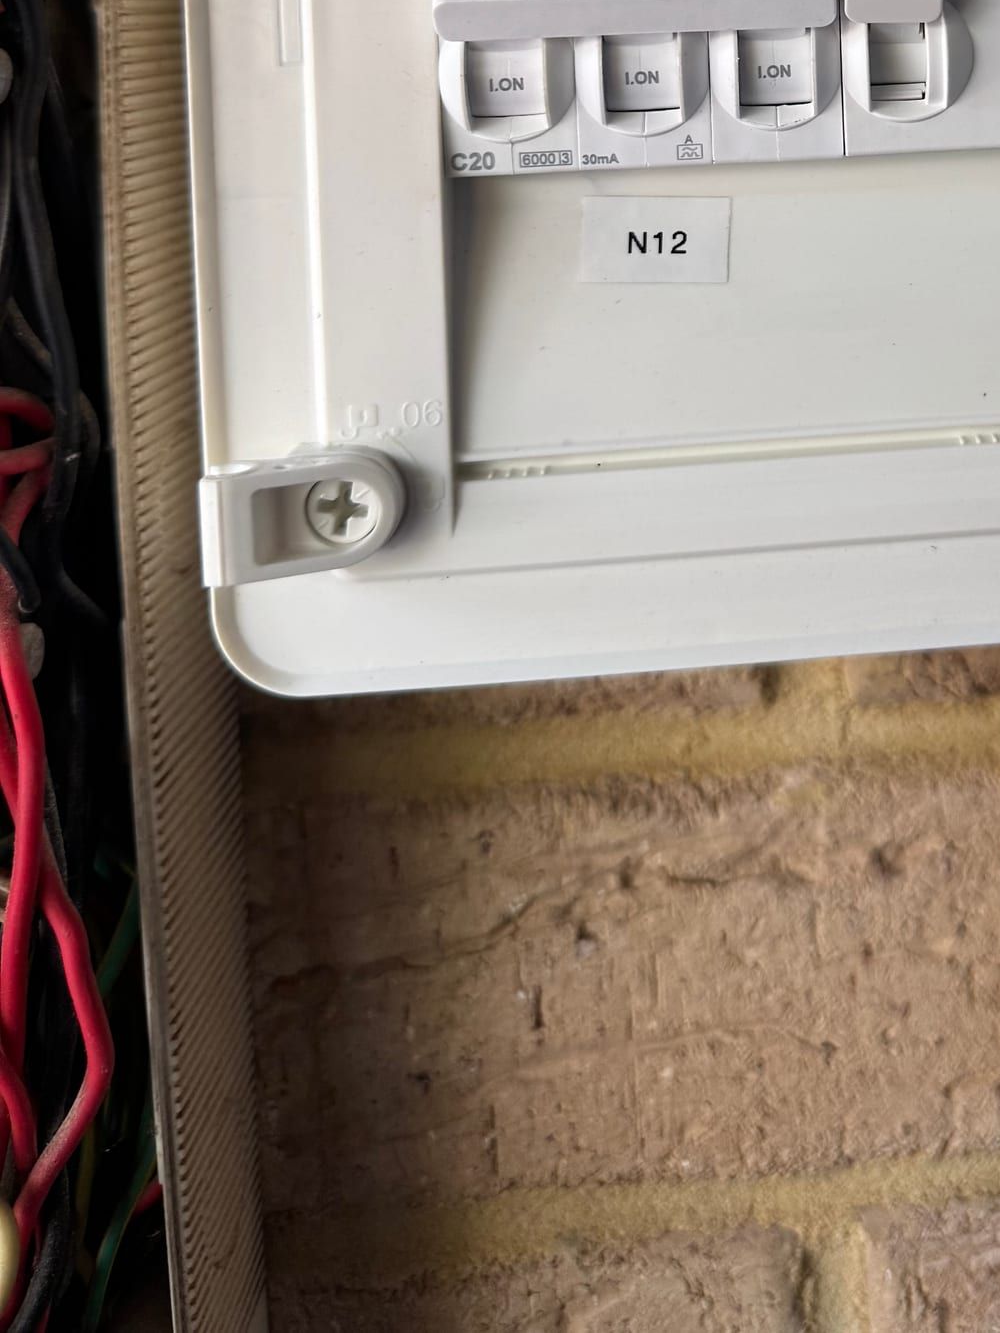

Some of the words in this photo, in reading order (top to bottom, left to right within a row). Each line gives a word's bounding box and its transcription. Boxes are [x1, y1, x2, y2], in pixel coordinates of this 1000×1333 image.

[624, 70, 660, 86] I.ON
[757, 64, 792, 79] I.ON
[489, 77, 525, 92] I.ON
[684, 134, 693, 144] A
[450, 152, 496, 171] C20
[522, 154, 556, 166] 6000
[561, 152, 571, 164] 3
[581, 153, 620, 165] 30mA
[627, 230, 688, 255] N12
